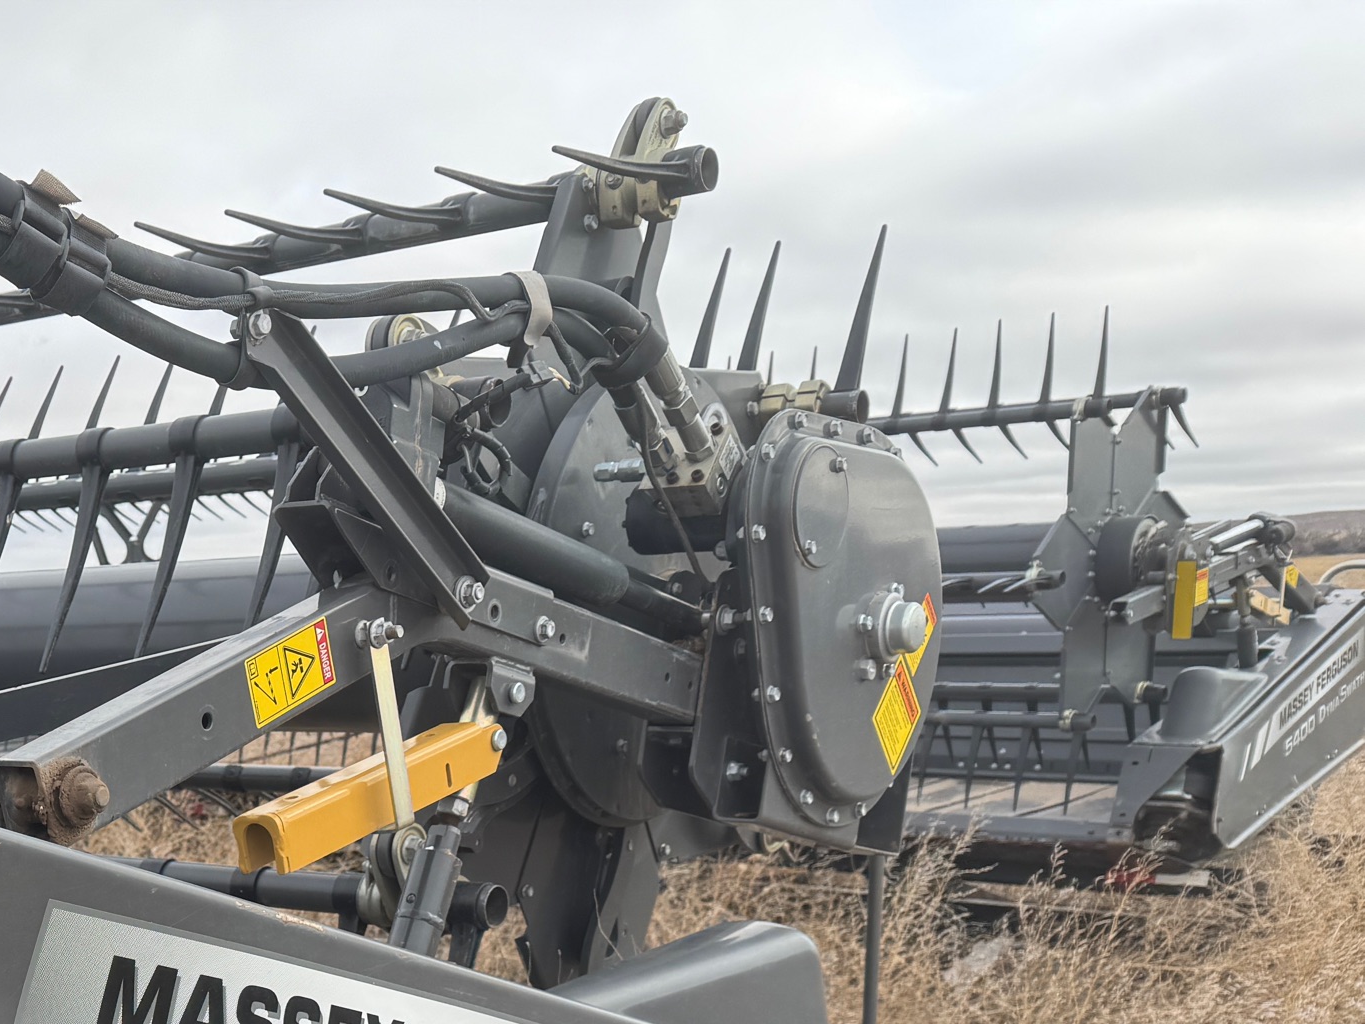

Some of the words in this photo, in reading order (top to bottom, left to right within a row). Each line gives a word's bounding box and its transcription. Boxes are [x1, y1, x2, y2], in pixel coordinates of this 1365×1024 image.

[318, 642, 331, 680] DANGER
[1279, 680, 1314, 730] MASSEY
[1316, 639, 1359, 695] FERGUSON
[1284, 715, 1315, 757] 5400
